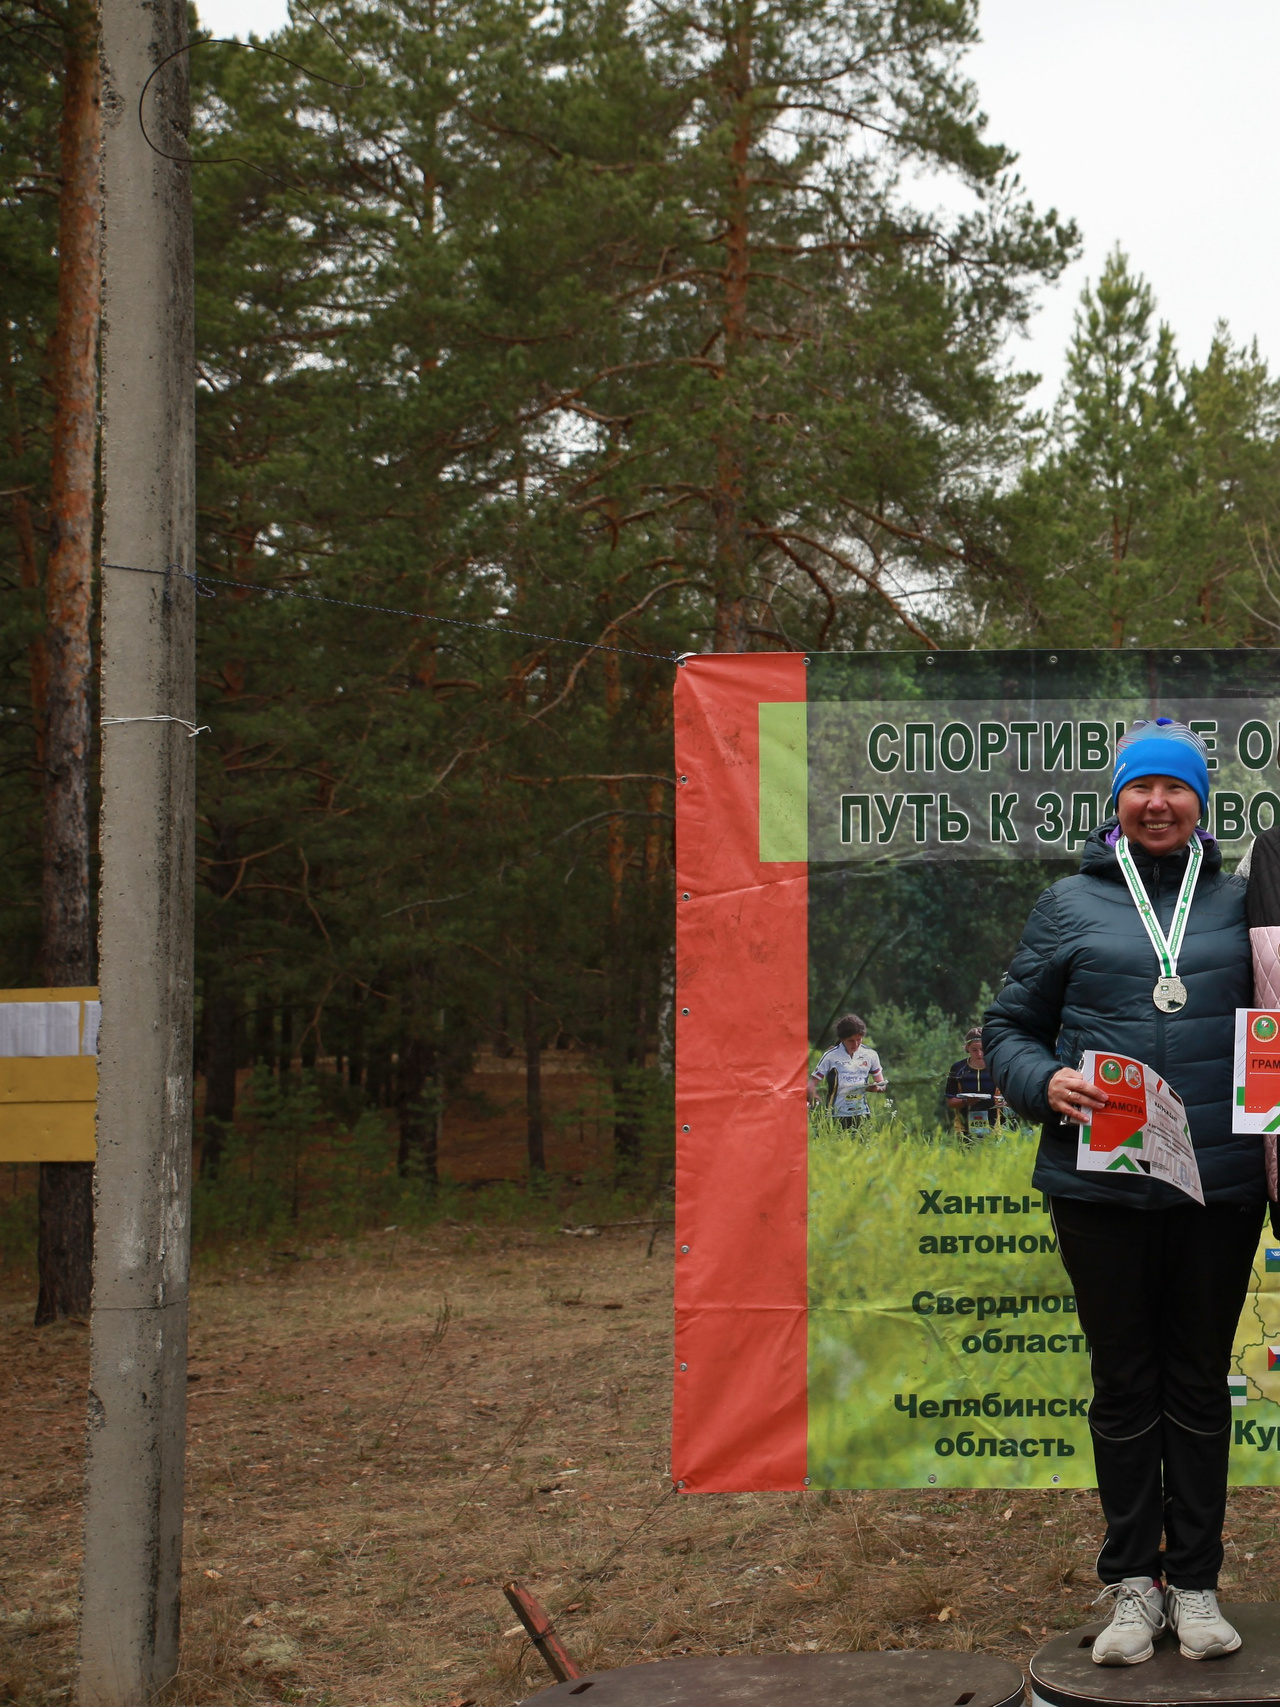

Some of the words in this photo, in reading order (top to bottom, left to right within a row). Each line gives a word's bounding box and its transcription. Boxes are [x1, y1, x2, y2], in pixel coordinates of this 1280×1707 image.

[868, 720, 1218, 773] СПОРТИВЕ
[841, 793, 970, 843] ПУТЬ
[990, 793, 1018, 843] К
[1104, 1100, 1144, 1115] РАМОТА
[918, 1234, 1060, 1254] автоном
[911, 1291, 1077, 1318] Свердлов
[894, 1393, 1088, 1419] Челябинск
[935, 1432, 1075, 1457] область
